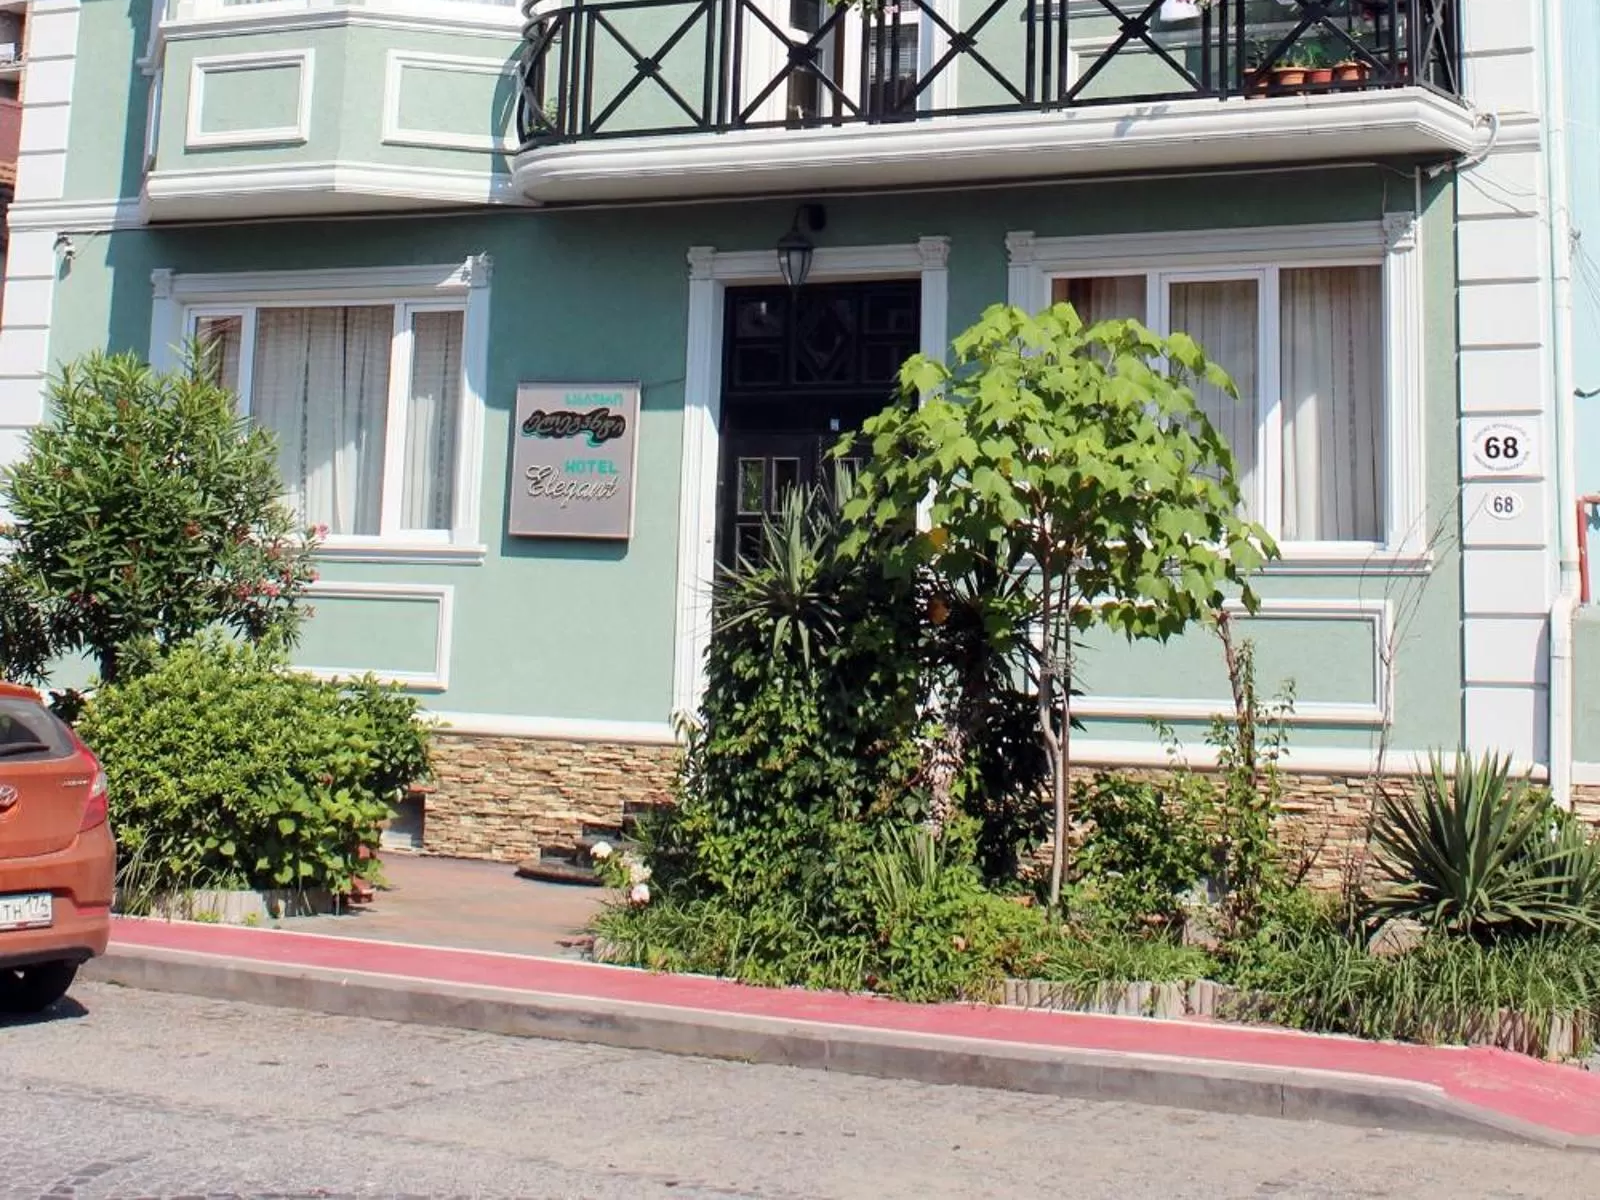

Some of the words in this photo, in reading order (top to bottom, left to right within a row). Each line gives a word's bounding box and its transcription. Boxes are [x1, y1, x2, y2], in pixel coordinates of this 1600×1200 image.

[1484, 436, 1519, 459] 68
[564, 459, 619, 474] HOTEL
[526, 465, 618, 509] Elegant
[1493, 496, 1513, 513] 68
